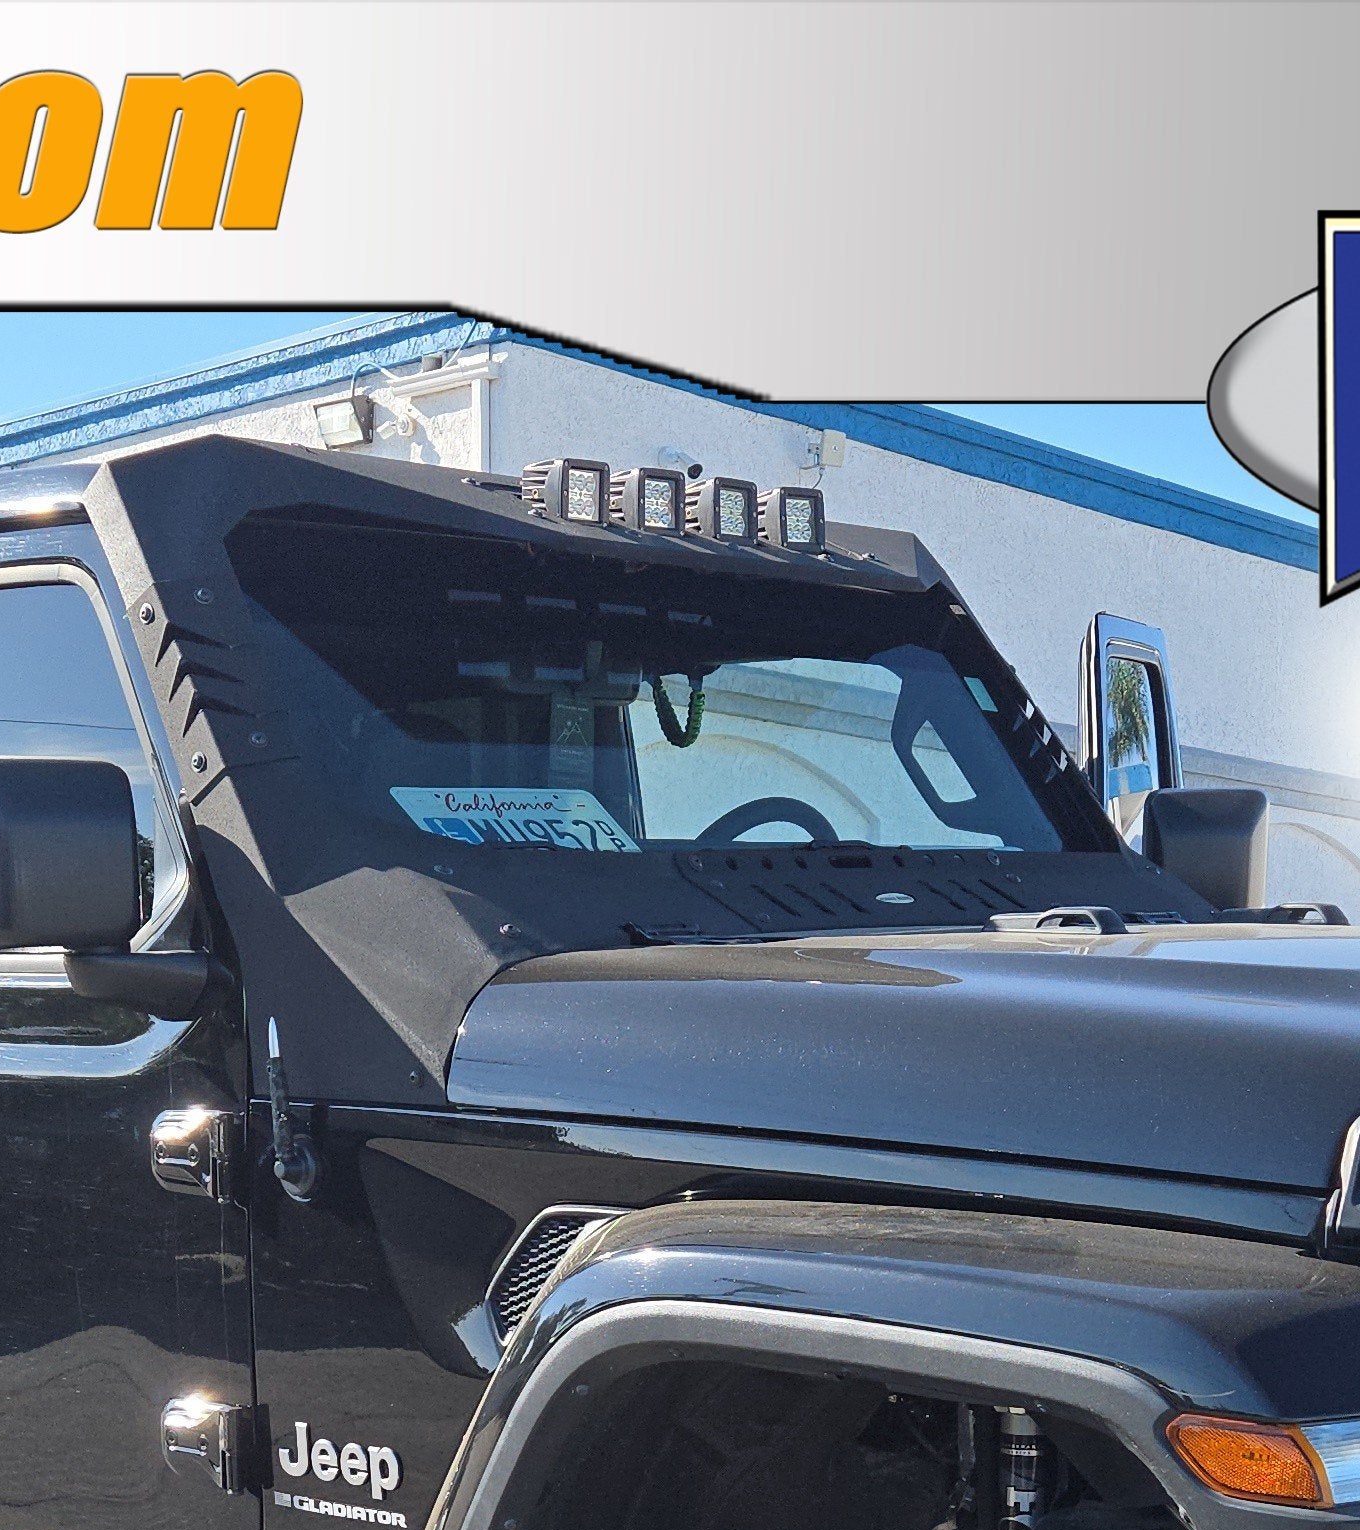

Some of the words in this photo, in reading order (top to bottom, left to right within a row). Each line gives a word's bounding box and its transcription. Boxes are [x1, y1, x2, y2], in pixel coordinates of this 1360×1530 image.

[445, 793, 571, 818] California
[278, 1421, 400, 1500] Jeep
[293, 1496, 408, 1529] GLADIATOR
